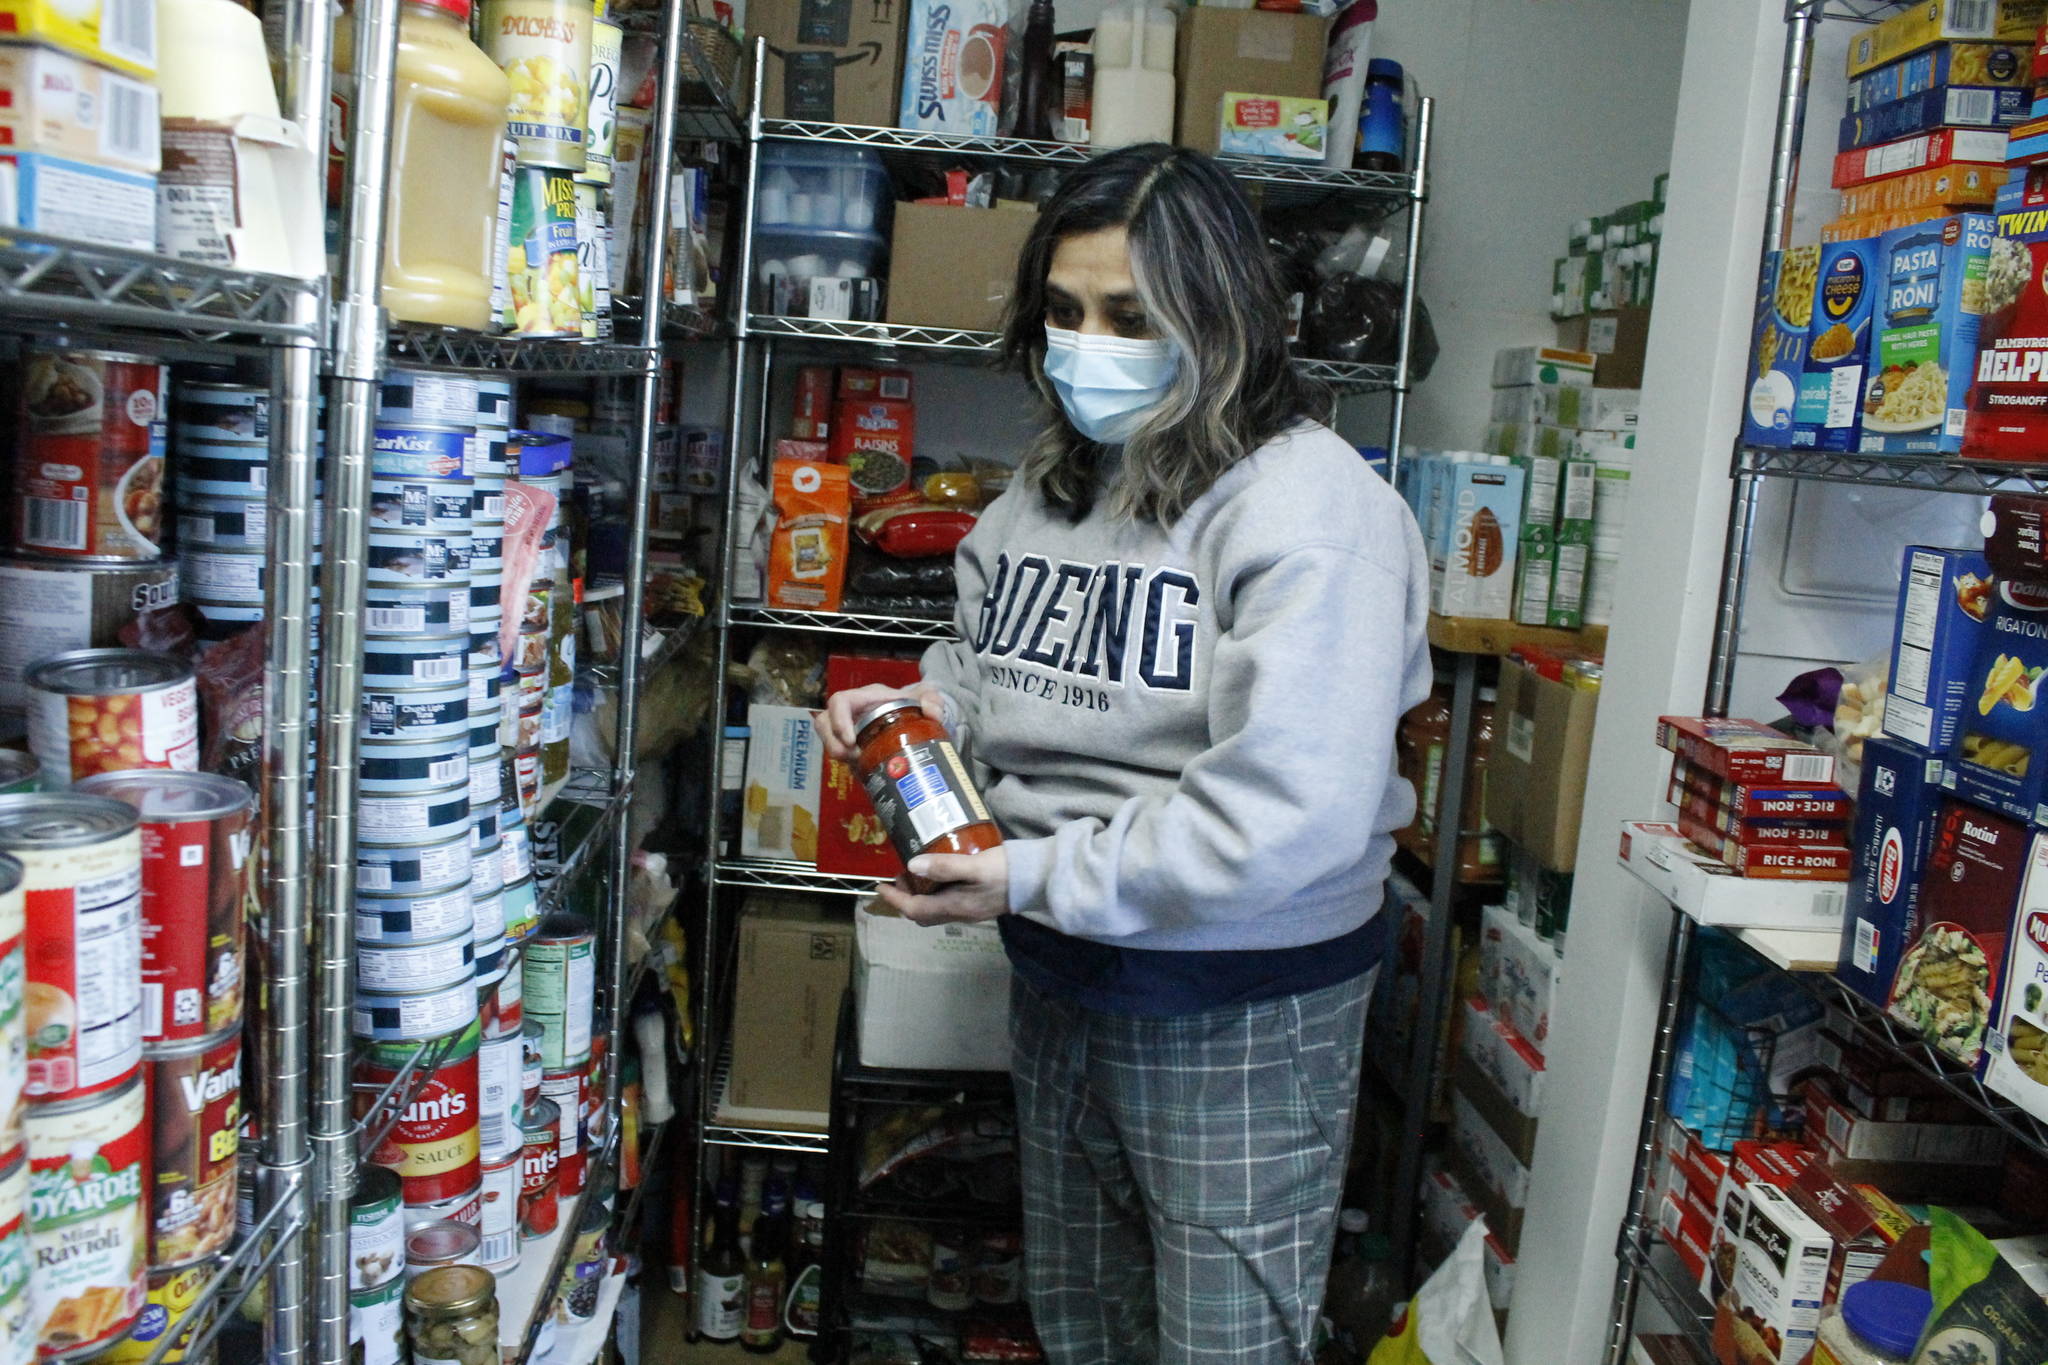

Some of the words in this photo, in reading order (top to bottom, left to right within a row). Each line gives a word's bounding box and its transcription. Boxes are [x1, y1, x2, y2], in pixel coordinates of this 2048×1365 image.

[502, 15, 576, 43] DUCHESS
[918, 55, 945, 122] SWISS
[507, 123, 540, 136] UIT
[1894, 249, 1937, 274] PASTA
[1892, 283, 1934, 310] RONI
[1989, 394, 2047, 406] STROGANOFF
[373, 434, 433, 451] arKist
[854, 437, 899, 452] RAISINS
[1451, 489, 1476, 605] ALMOND
[991, 666, 1058, 701] SINCE
[1061, 685, 1110, 712] 1916
[791, 719, 811, 791] PREMIUM
[1762, 801, 1795, 812] RONI
[1802, 801, 1835, 812] RICE
[1758, 827, 1788, 839] RONI
[1798, 829, 1829, 840] RICE
[1871, 813, 1884, 857] JUMBO
[1963, 820, 2000, 846] Rotini
[1763, 855, 1795, 866] RICE
[1803, 855, 1838, 867] RONI
[1881, 843, 1898, 900] Barilla
[1864, 859, 1877, 904] SHELLS
[383, 1092, 467, 1122] unt's
[414, 1142, 466, 1165] SAUCE
[27, 1162, 141, 1222] OYARDEE
[36, 1226, 121, 1269] Ravioli
